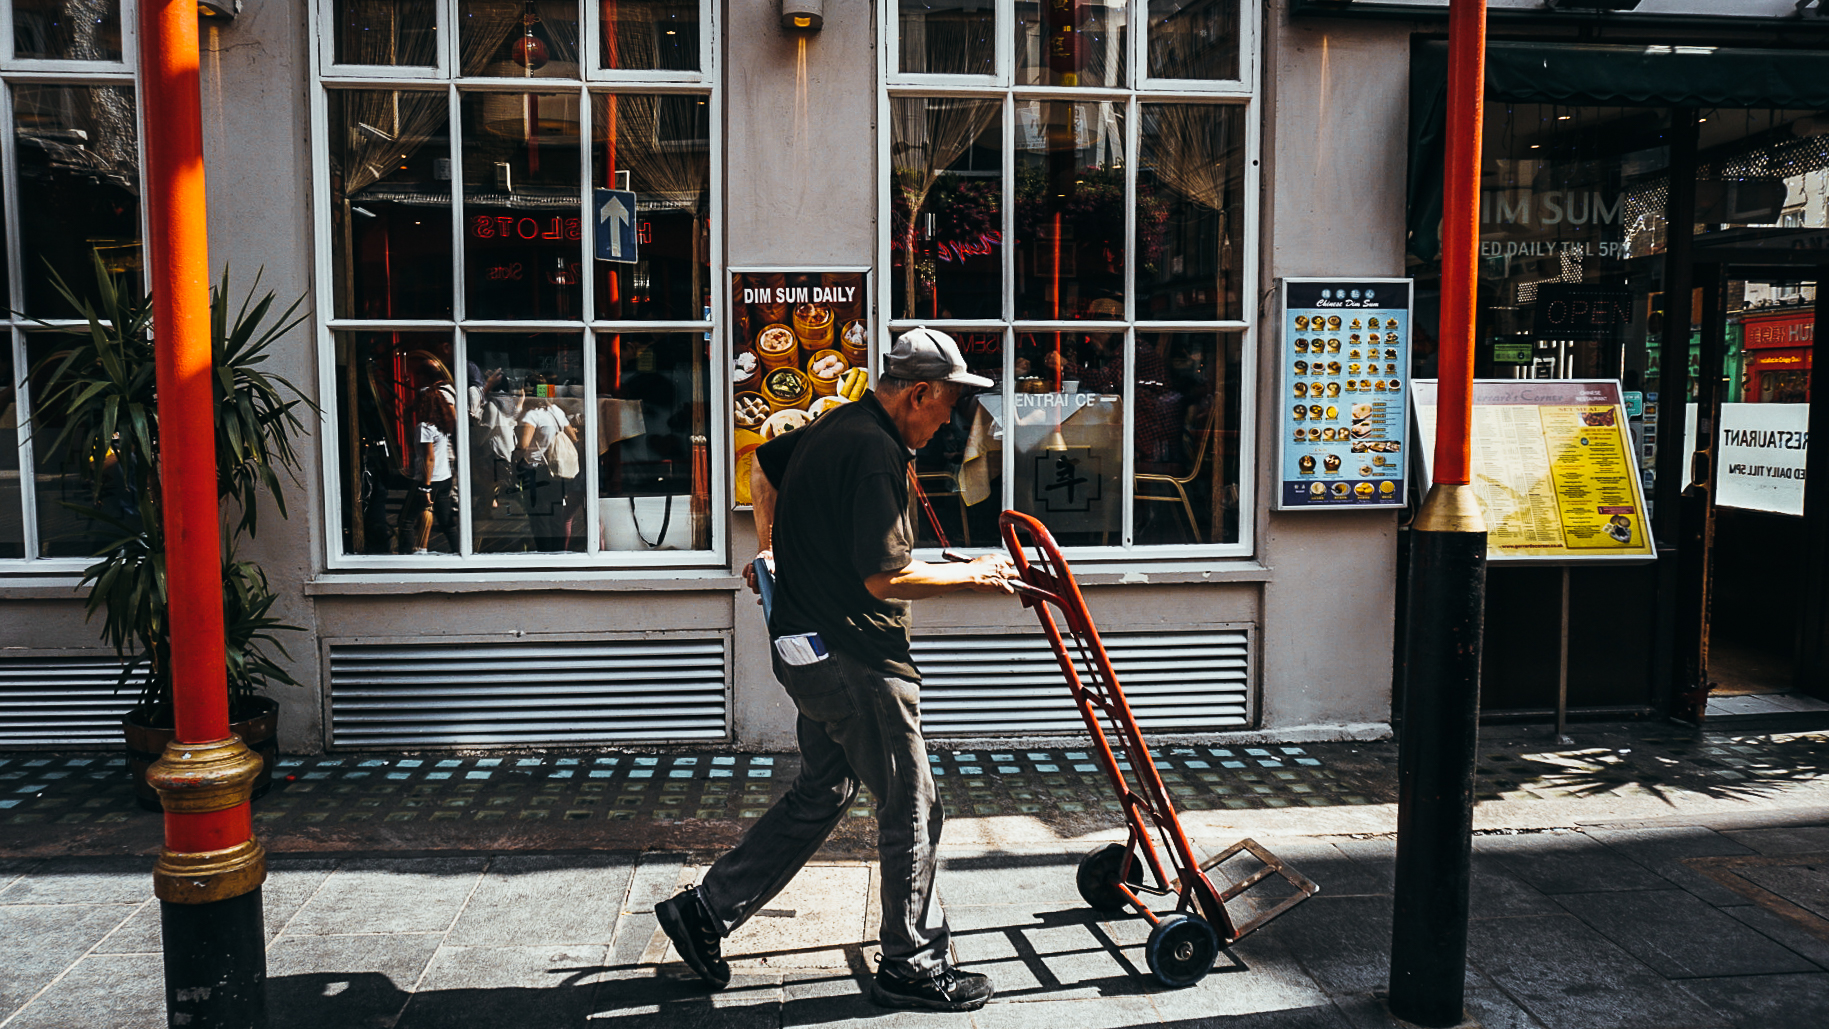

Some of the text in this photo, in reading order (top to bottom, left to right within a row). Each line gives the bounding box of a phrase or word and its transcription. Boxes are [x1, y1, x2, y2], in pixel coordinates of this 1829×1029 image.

[1481, 191, 1626, 225] IM SUM
[1506, 242, 1557, 257] DAILY
[1560, 242, 1594, 257] TILL
[744, 286, 856, 304] DIM SUM DAILY
[1316, 299, 1379, 308] Chinese Dim Sum
[1547, 300, 1632, 324] OPEN
[1520, 389, 1564, 402] Corner
